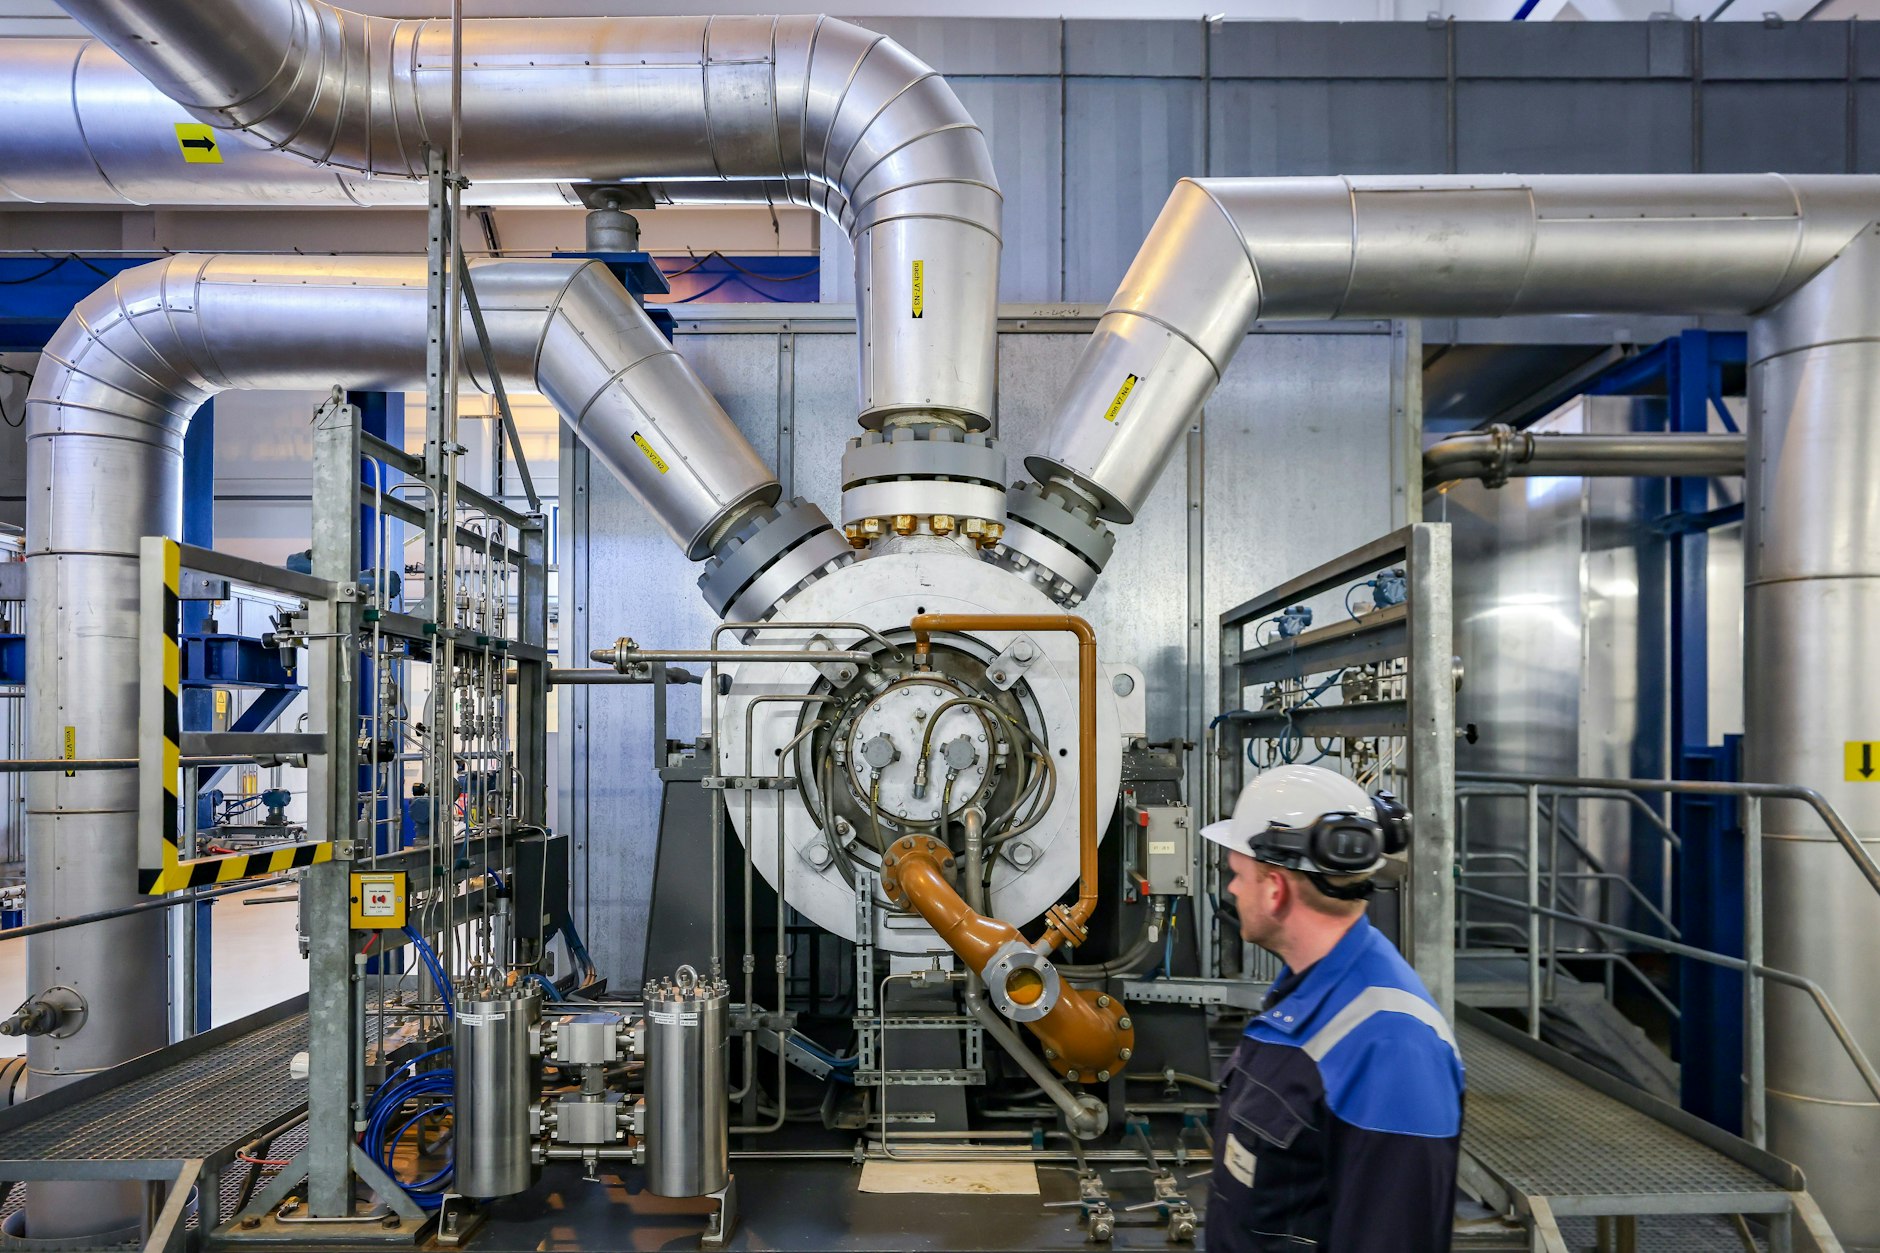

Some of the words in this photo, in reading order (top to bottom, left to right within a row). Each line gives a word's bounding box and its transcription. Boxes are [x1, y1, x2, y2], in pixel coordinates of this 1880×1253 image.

[1110, 406, 1118, 417] von
[1116, 387, 1130, 405] V7-N4
[640, 443, 650, 454] von
[649, 453, 665, 469] V7-N2
